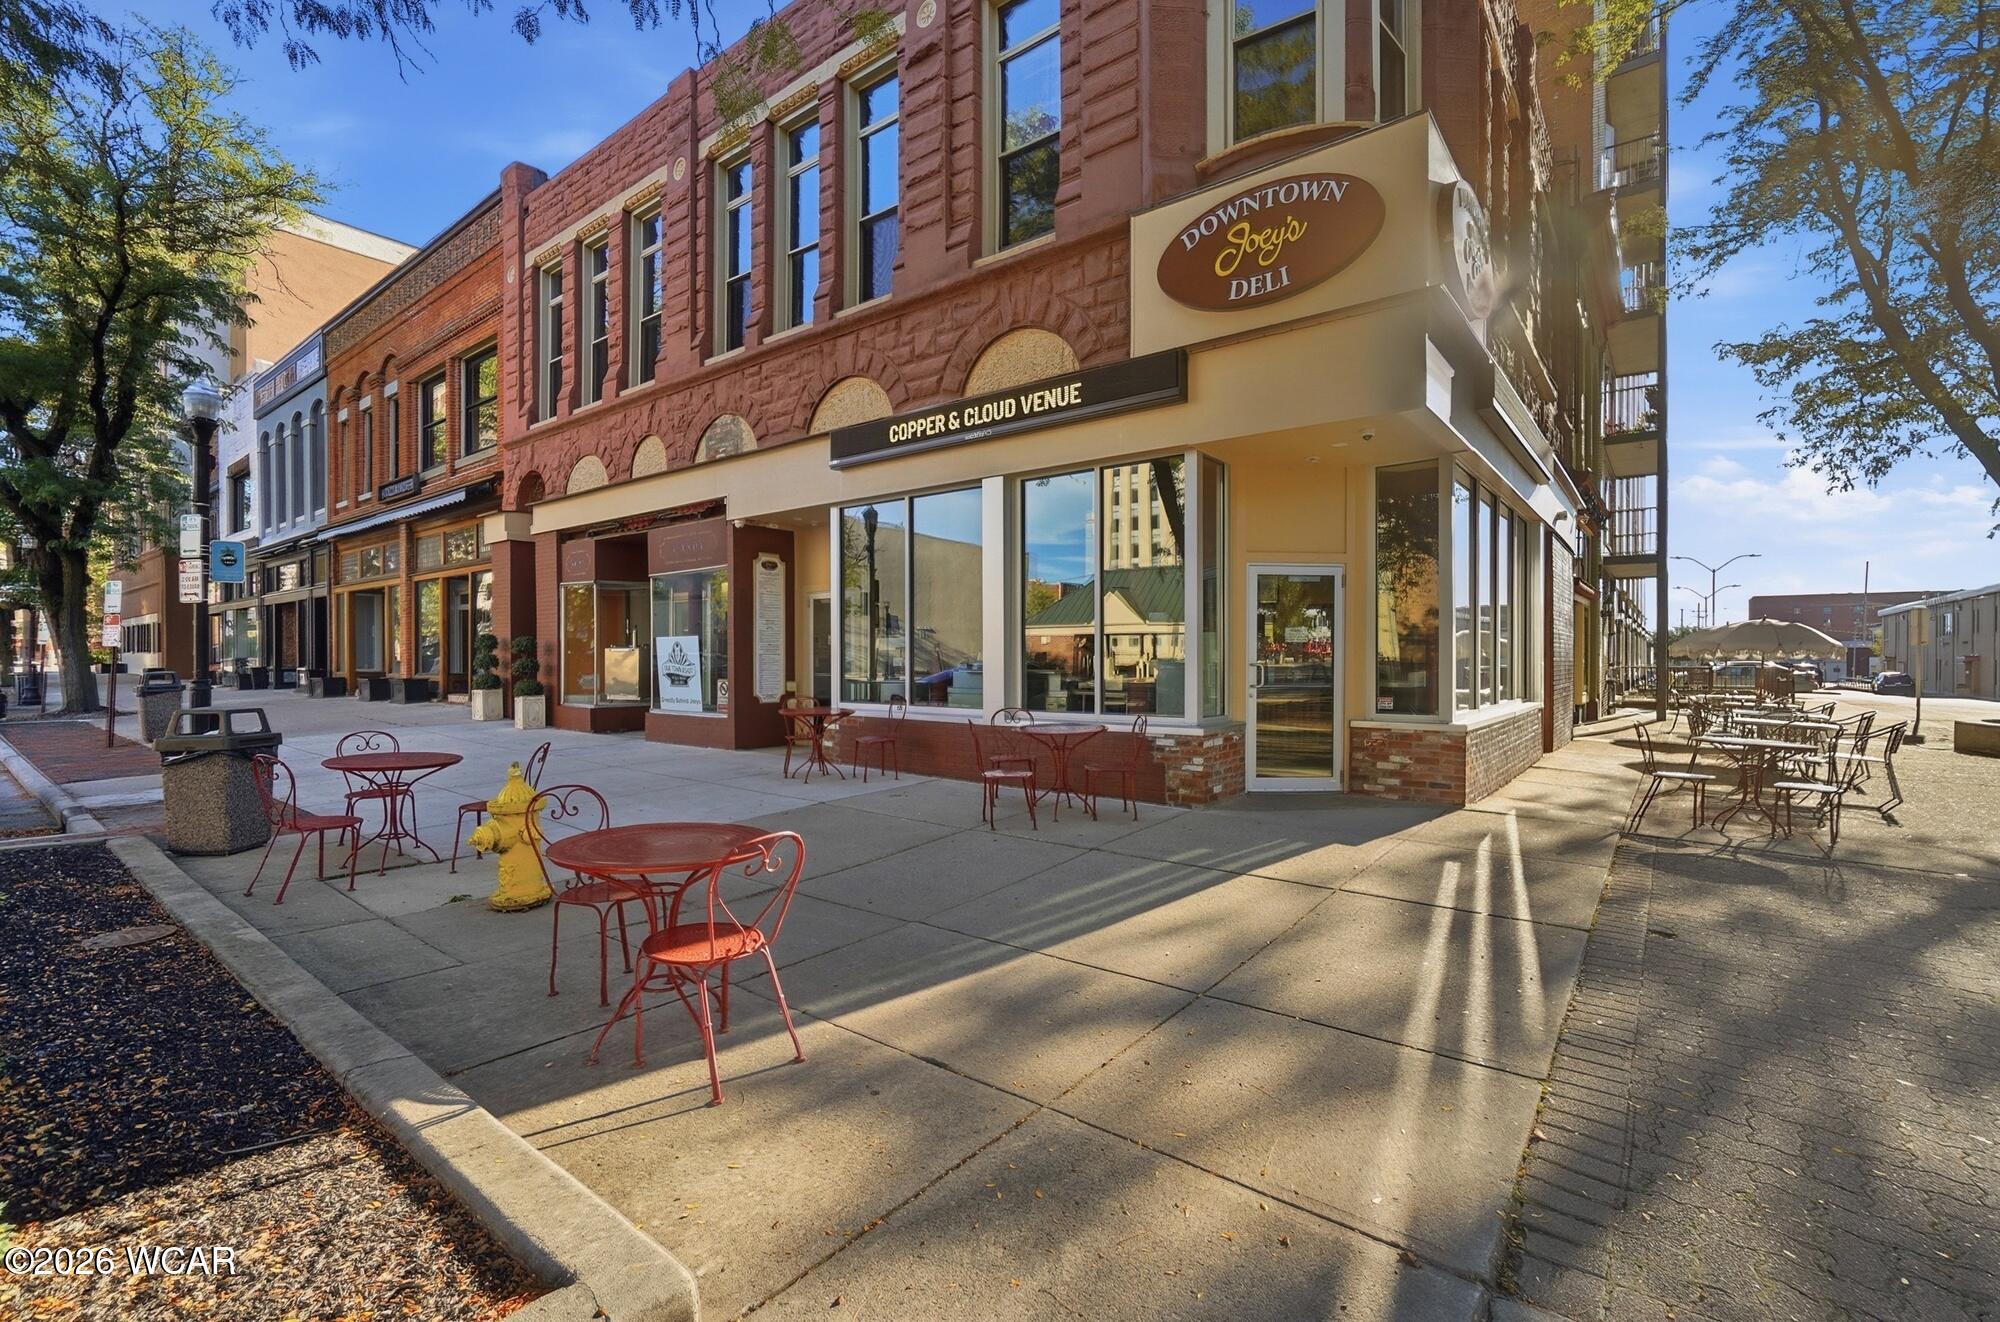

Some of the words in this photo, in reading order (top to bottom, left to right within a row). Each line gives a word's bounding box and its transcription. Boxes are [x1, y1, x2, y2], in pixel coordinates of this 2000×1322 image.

[1180, 180, 1349, 251] DOWNTOWN
[1214, 215, 1307, 277] Joey's
[1228, 265, 1291, 300] DELI
[889, 414, 945, 443] COPPER
[948, 411, 960, 430] &
[964, 398, 1016, 427] CLOUD
[1020, 382, 1082, 414] VENUE
